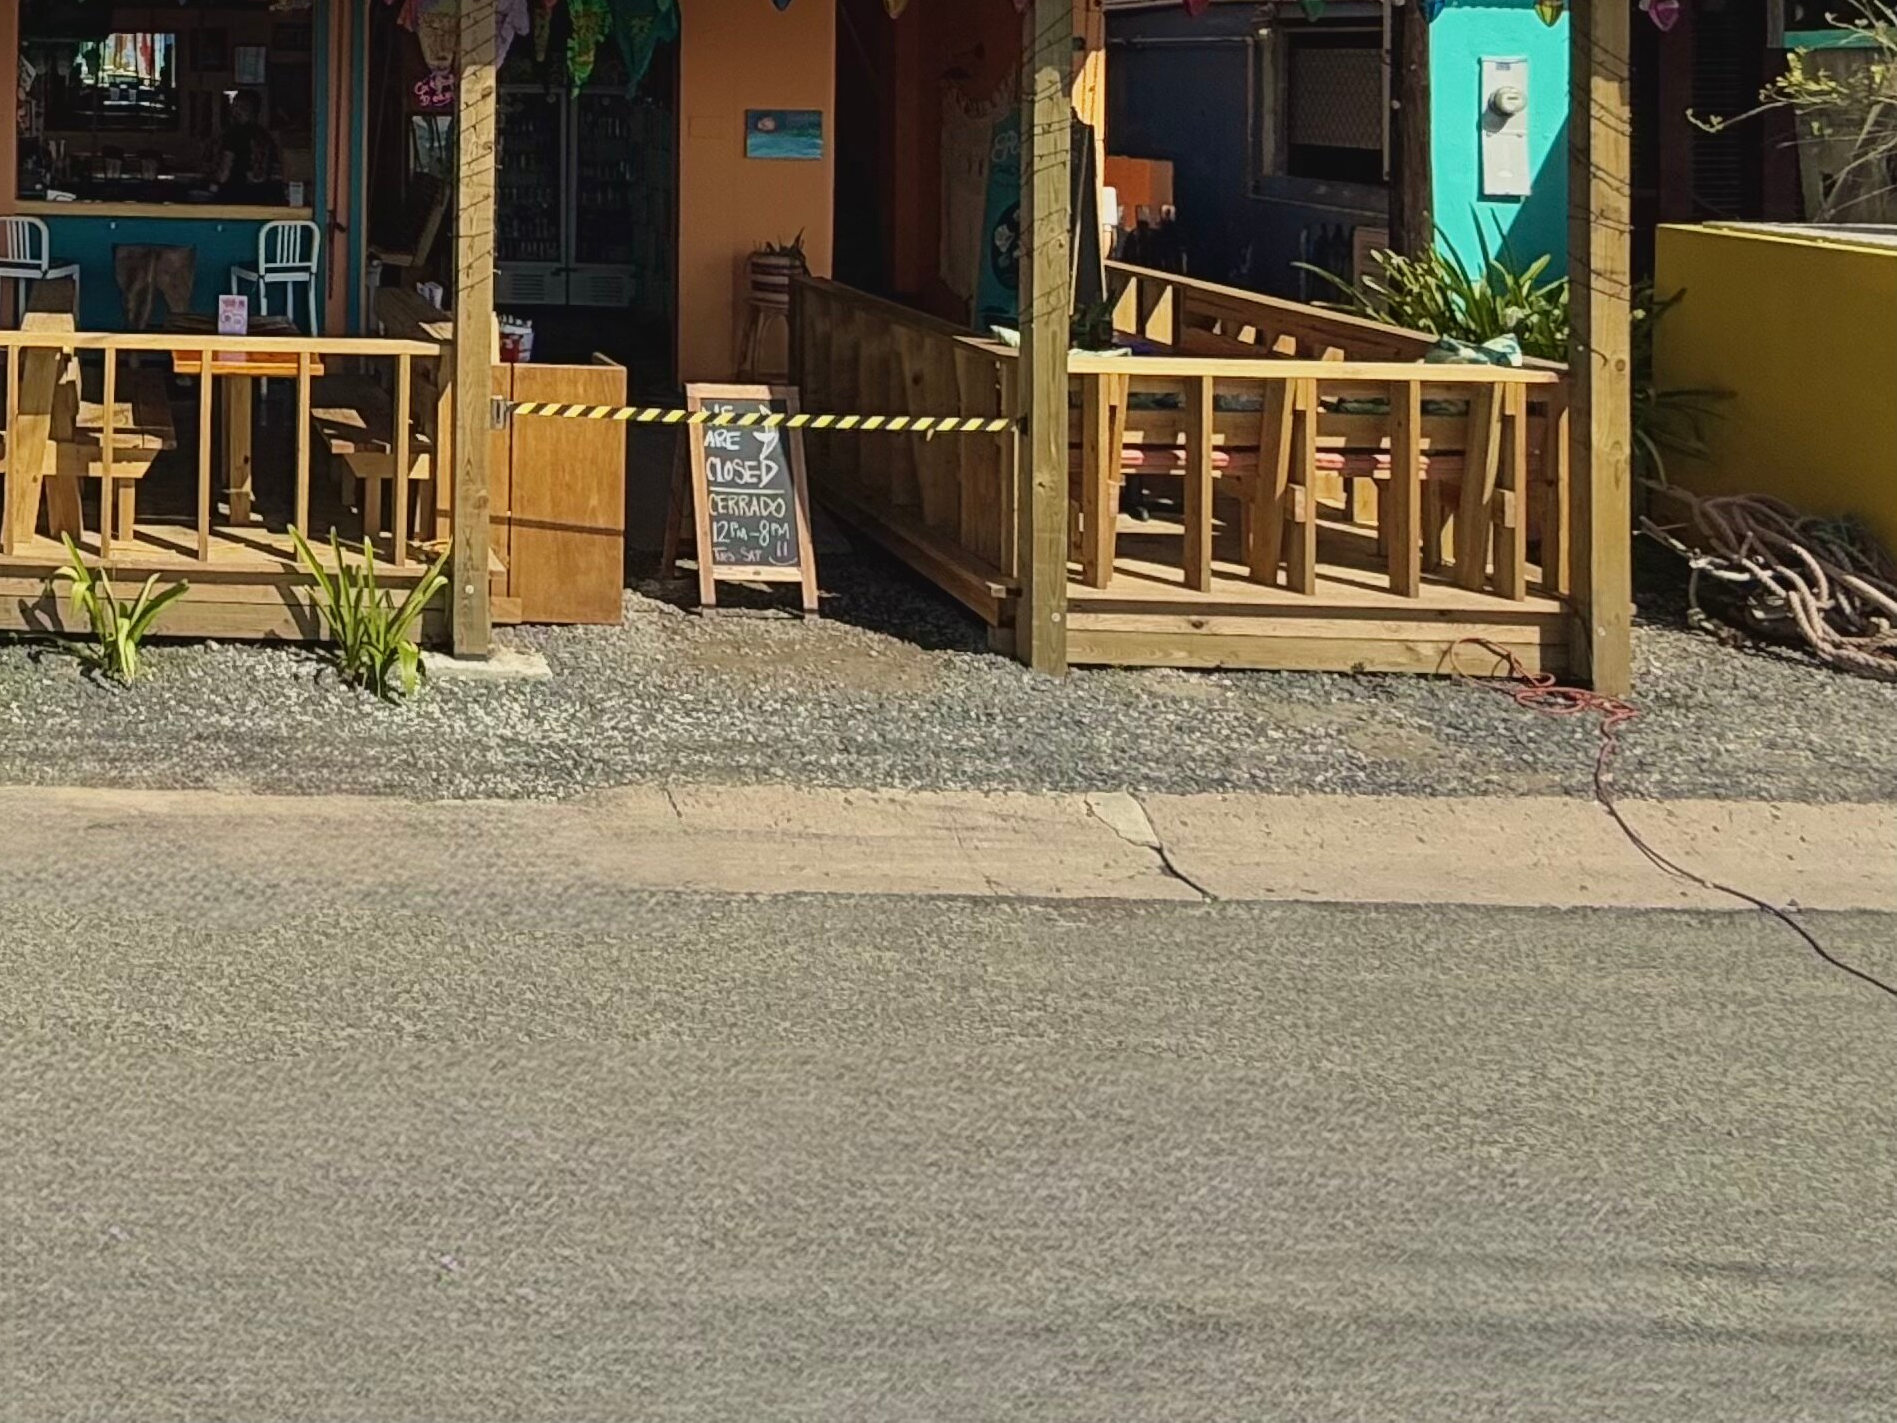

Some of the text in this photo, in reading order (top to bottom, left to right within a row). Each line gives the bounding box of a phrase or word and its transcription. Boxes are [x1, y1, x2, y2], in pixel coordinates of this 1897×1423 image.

[703, 428, 742, 450] ARE
[706, 456, 779, 488] CLOSED
[708, 493, 786, 518] CERRADO
